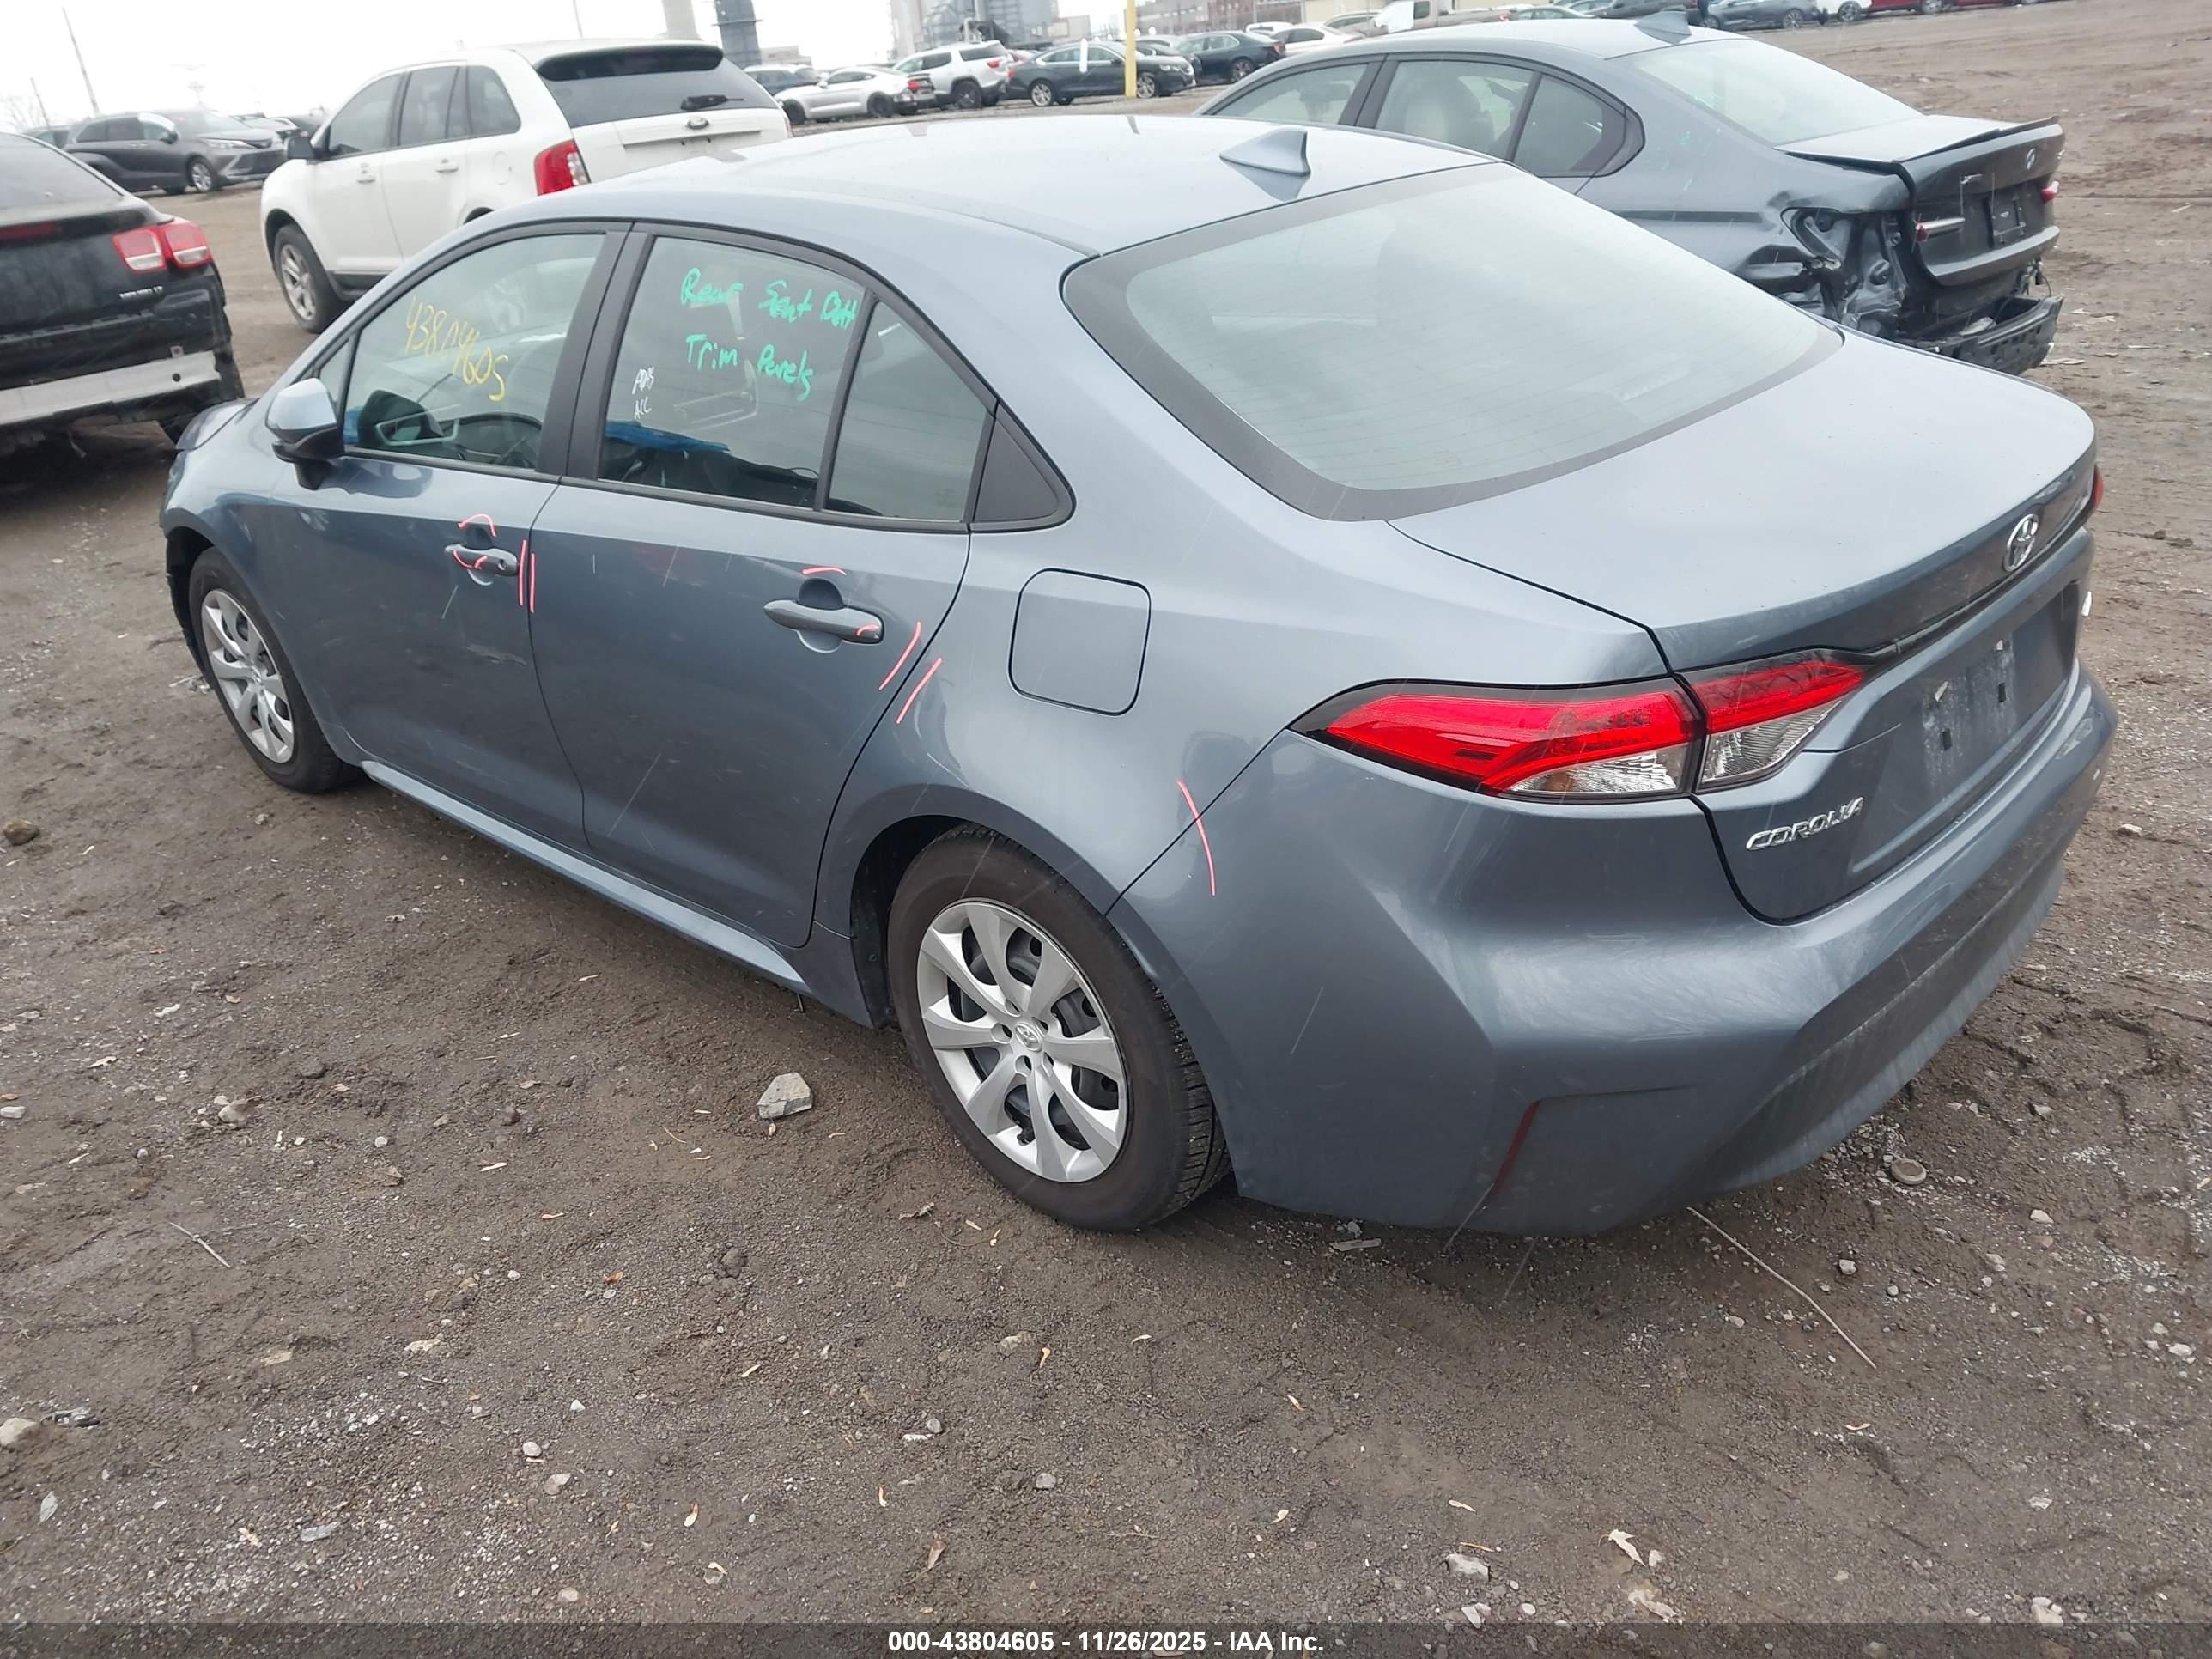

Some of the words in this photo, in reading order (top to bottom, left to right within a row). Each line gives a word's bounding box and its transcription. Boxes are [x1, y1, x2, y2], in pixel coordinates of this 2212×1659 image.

[681, 268, 744, 304] Rear
[758, 280, 813, 323] Seat
[405, 295, 509, 401] 43804605
[686, 333, 738, 371] Trim
[757, 344, 814, 402] Panels
[1746, 797, 1864, 850] COROLLA
